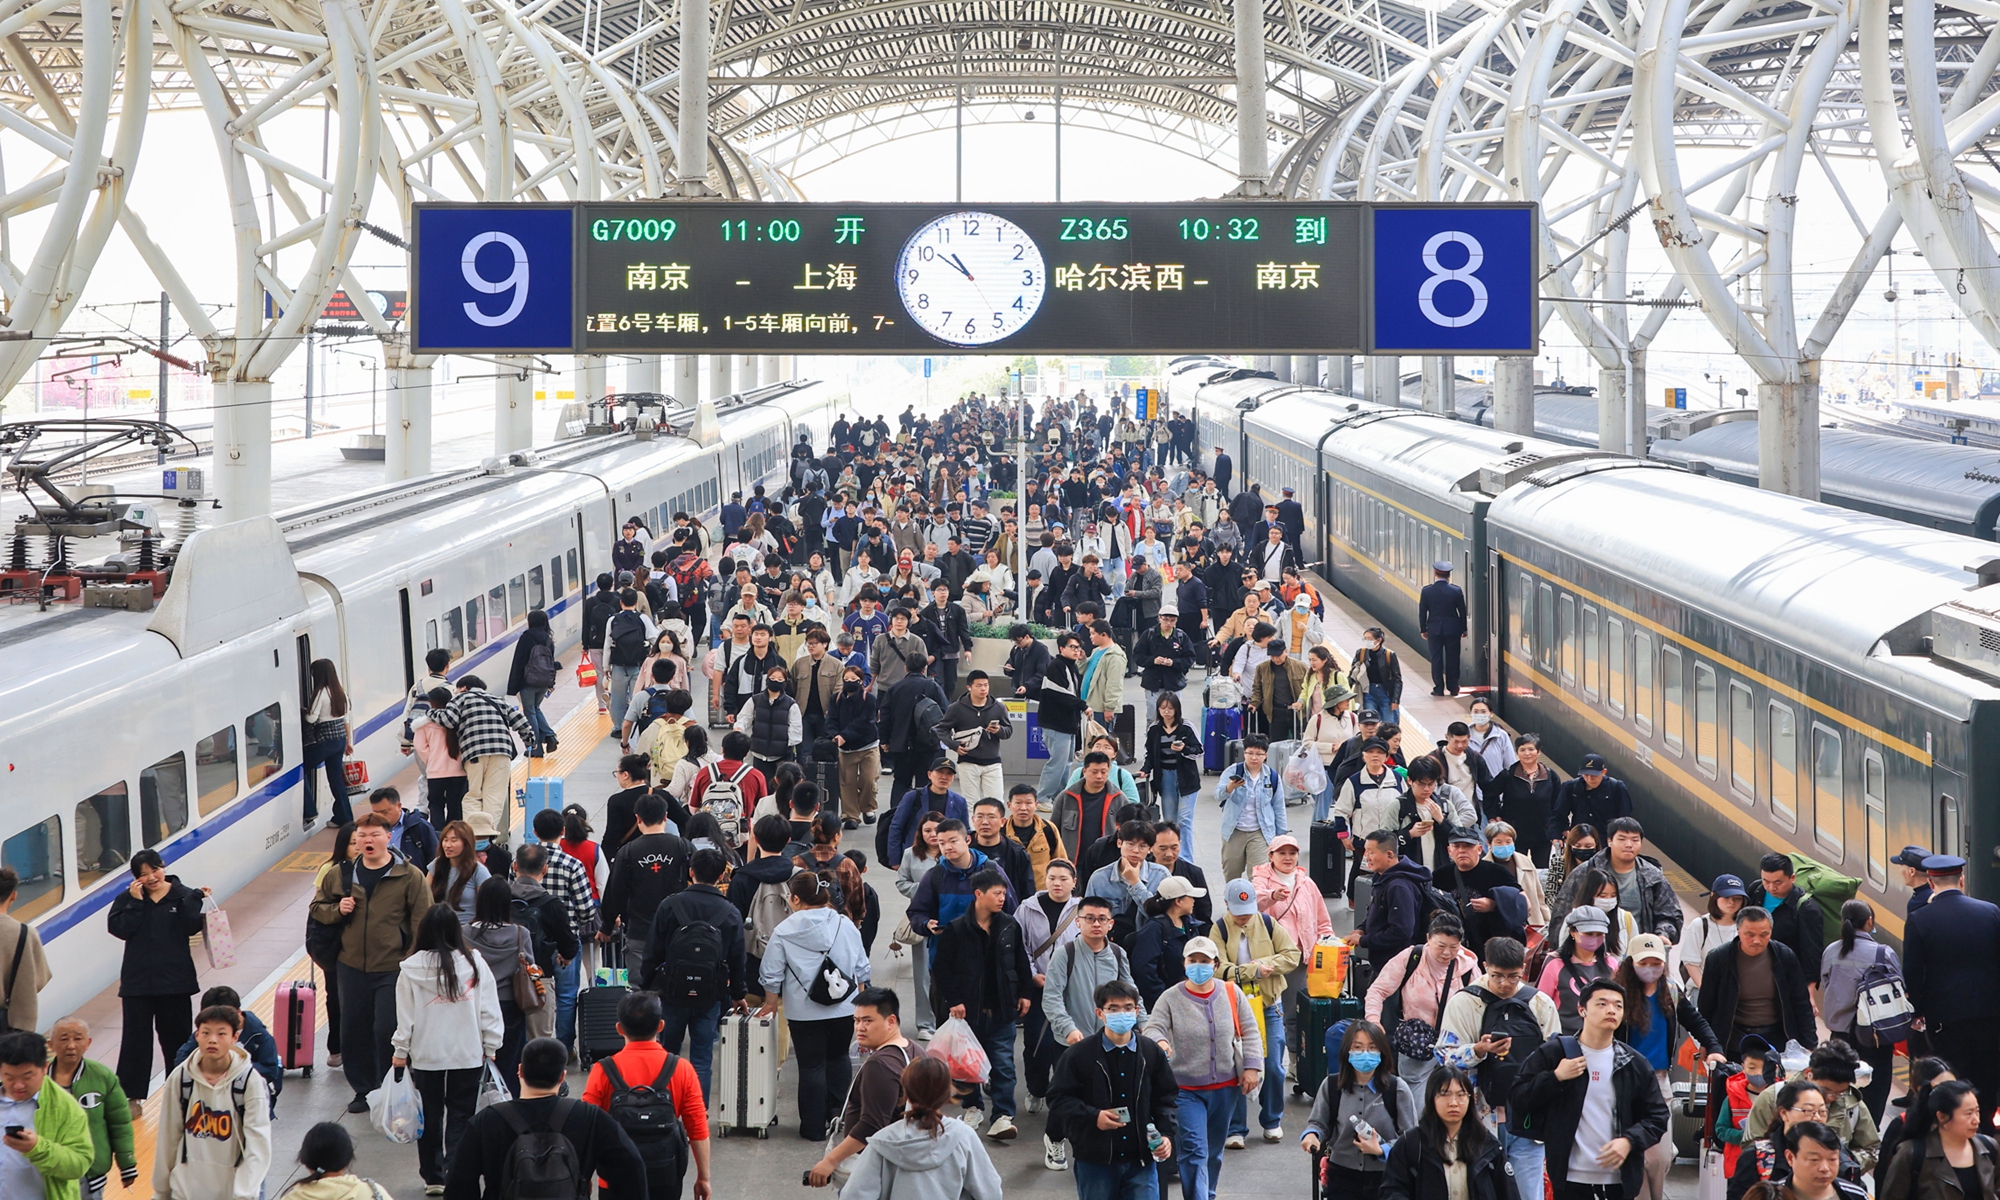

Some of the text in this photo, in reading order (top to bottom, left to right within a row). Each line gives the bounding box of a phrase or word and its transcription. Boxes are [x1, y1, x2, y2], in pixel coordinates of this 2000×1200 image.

[591, 216, 866, 245] G7009 11:00 开
[938, 228, 950, 244] 11
[963, 220, 980, 236] 12
[996, 227, 1002, 242] 1
[1059, 215, 1328, 245] Z365 10:32 到
[918, 246, 935, 261] 10
[1013, 244, 1024, 260] 2
[461, 231, 530, 327] 9
[626, 262, 691, 291] 南京
[792, 262, 858, 291] 上海
[908, 269, 919, 285] 9
[1022, 270, 1033, 286] 3
[1054, 261, 1186, 291] 哈尔滨西
[1255, 261, 1321, 291] 南京
[1418, 230, 1489, 328] 8
[918, 294, 929, 309] 8
[1012, 296, 1024, 312] 4
[942, 311, 953, 327] 7
[965, 318, 976, 334] 6
[992, 312, 1004, 328] 5
[637, 853, 674, 868] NOAH
